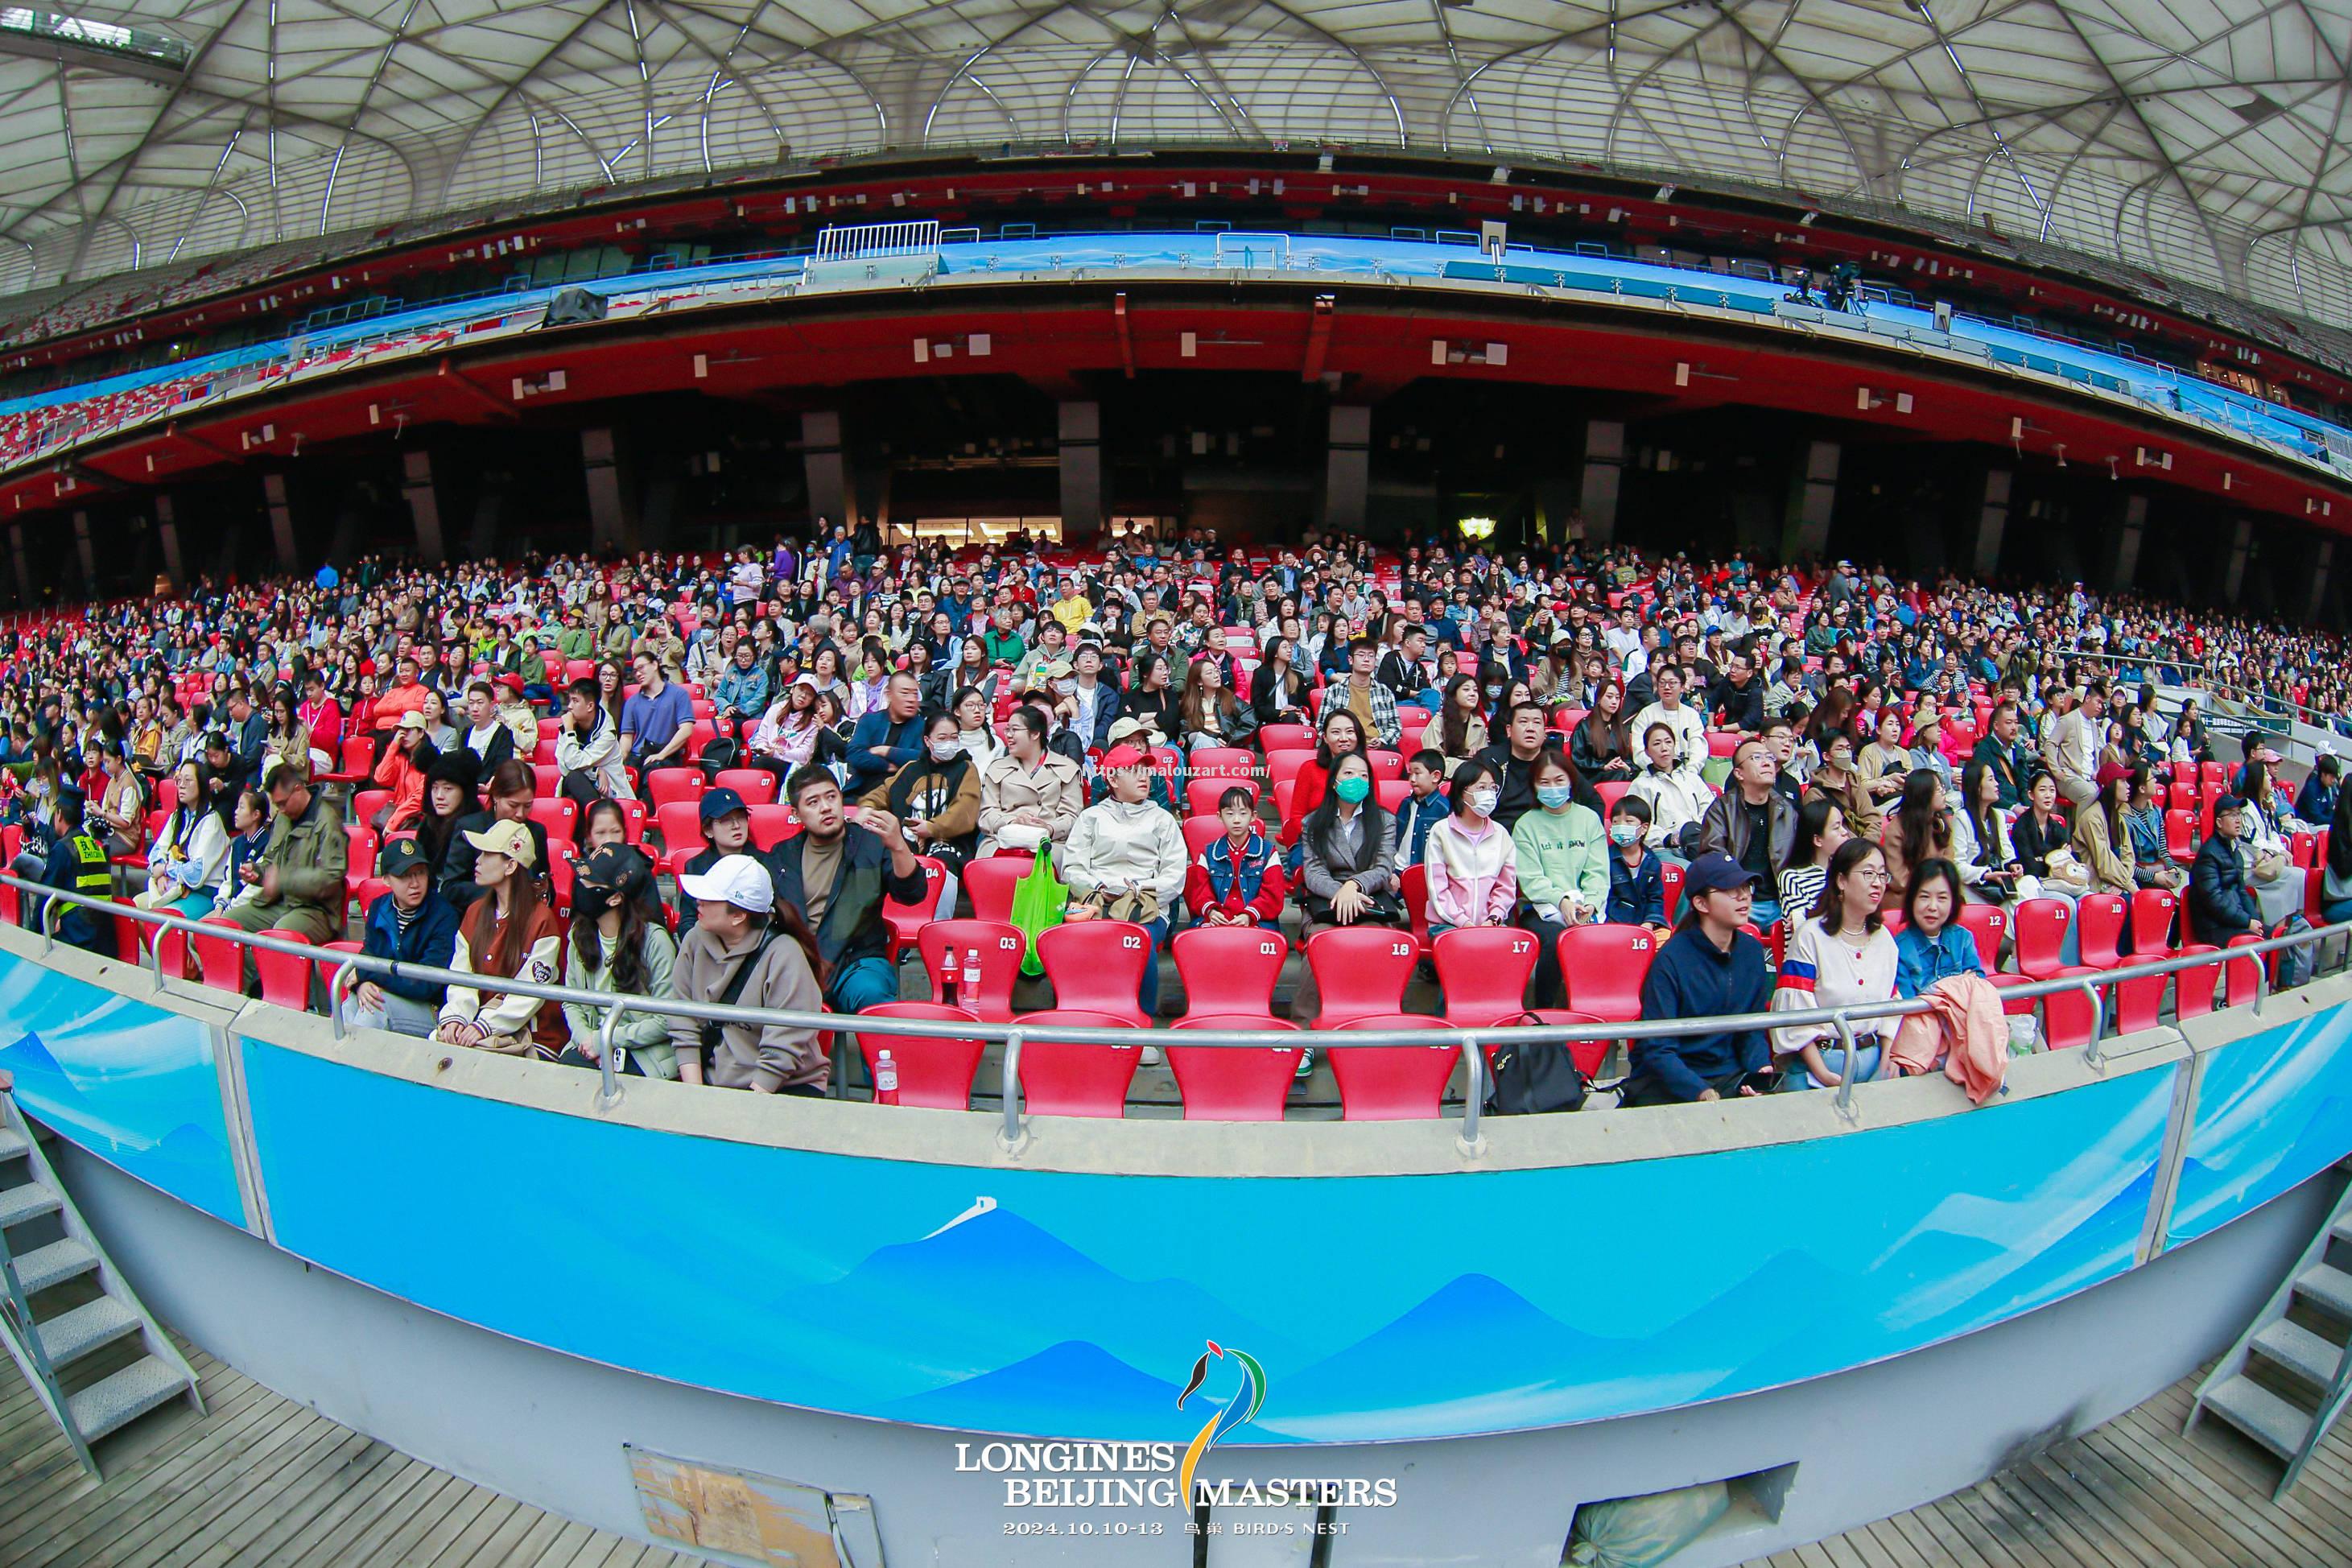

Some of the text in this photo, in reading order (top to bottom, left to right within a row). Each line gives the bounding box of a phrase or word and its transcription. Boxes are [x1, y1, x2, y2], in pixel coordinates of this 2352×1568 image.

[1418, 712, 1427, 720] 16
[1162, 756, 1174, 764] 02
[1240, 756, 1249, 764] 01
[1387, 757, 1398, 766] 17
[761, 778, 770, 786] 07
[563, 849, 572, 860] 08
[926, 868, 939, 878] 04
[1665, 872, 1678, 883] 15
[559, 906, 570, 918] 07
[2111, 904, 2122, 914] 10
[2055, 910, 2065, 920] 11
[1989, 916, 2001, 927] 12
[1000, 937, 1017, 950] 03
[1123, 936, 1141, 949] 02
[1512, 941, 1530, 954] 17
[1632, 939, 1648, 951] 16
[1261, 942, 1277, 955] 01
[1392, 943, 1409, 956] 18
